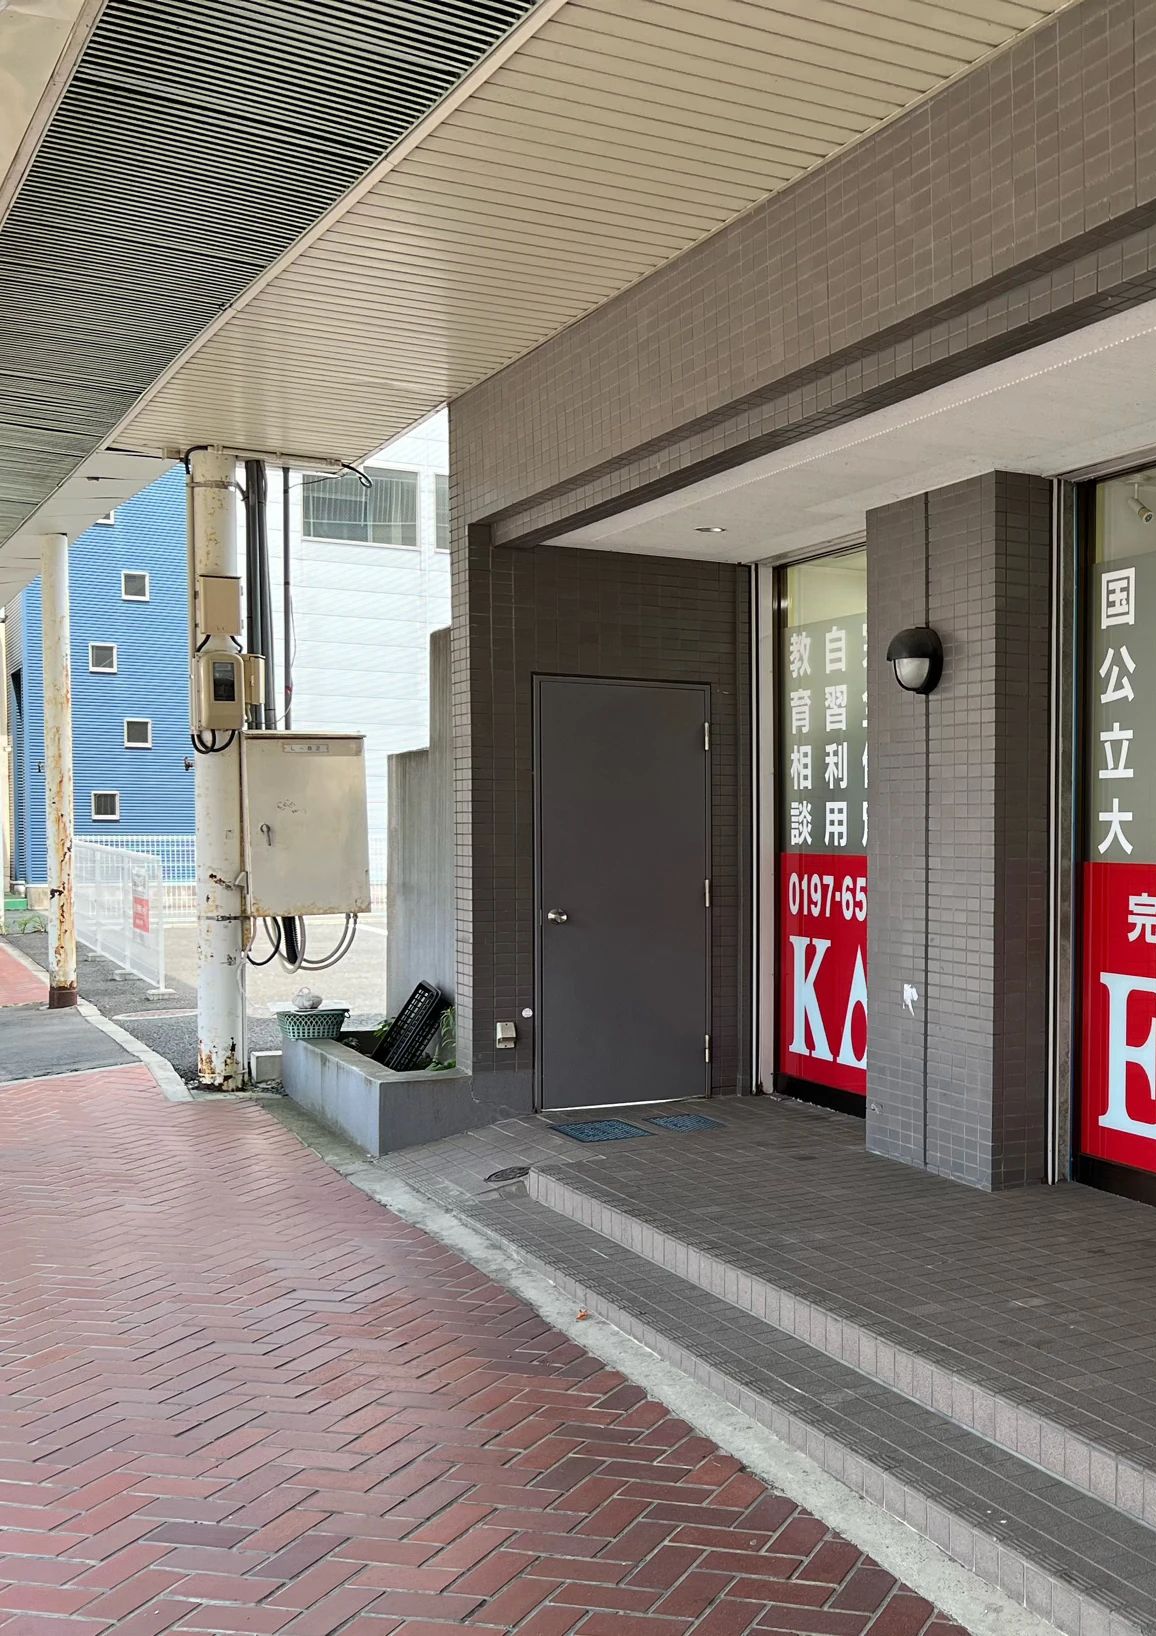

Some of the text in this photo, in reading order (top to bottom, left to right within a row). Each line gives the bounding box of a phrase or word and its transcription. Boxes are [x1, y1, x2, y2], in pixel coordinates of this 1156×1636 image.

[789, 632, 813, 846] 教育相談
[824, 626, 848, 847] 自習利用
[1097, 566, 1137, 855] 国公立大
[788, 872, 867, 922] 0197-65
